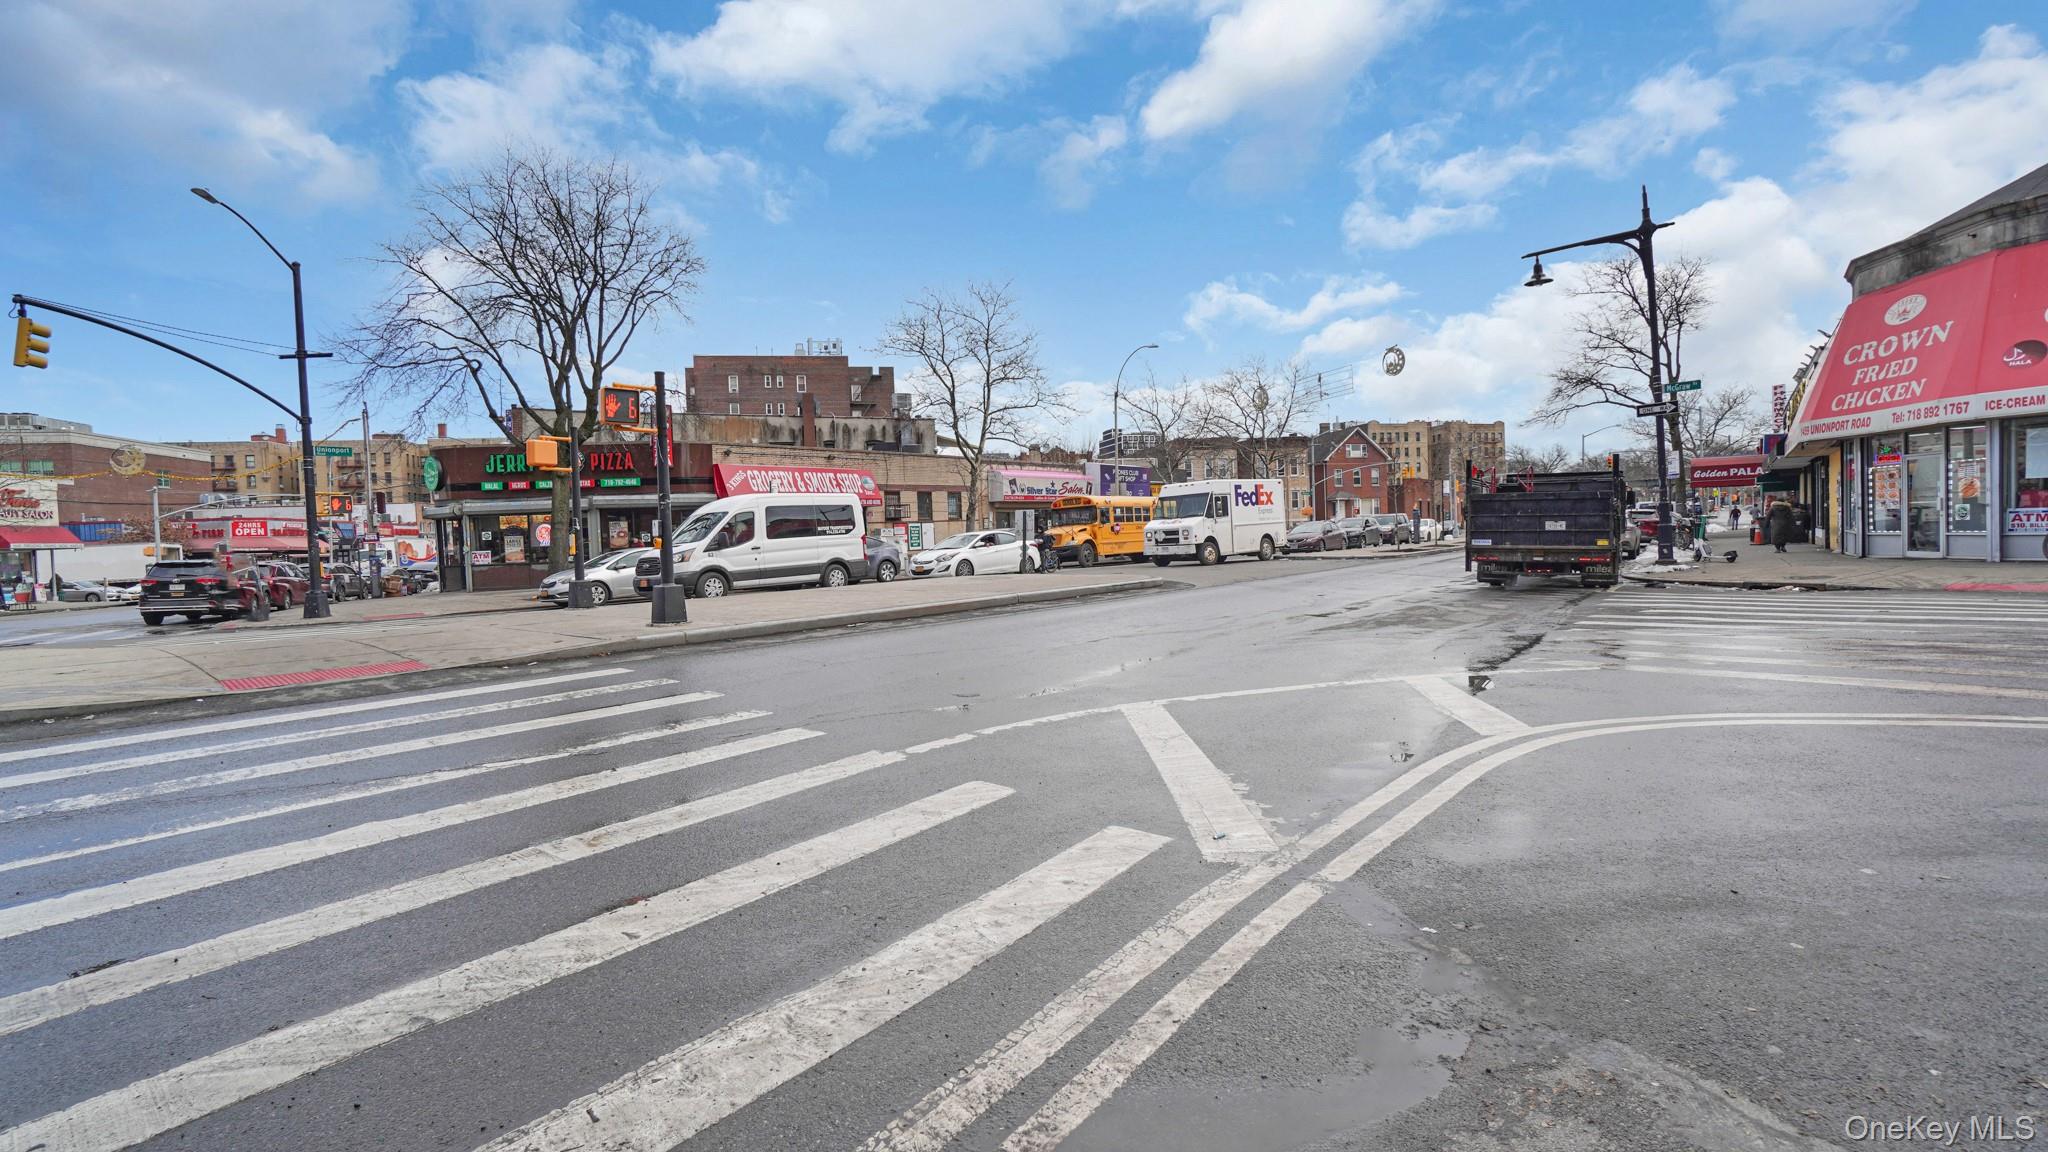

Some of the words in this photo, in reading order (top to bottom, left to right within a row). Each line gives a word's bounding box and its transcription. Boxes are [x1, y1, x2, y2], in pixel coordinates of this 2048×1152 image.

[1843, 320, 1954, 366] CROWN
[1851, 357, 1918, 386] FRIED
[1666, 383, 1691, 391] McGraw
[1831, 378, 1928, 412] CHICKEN
[628, 397, 637, 419] 6
[1984, 394, 2046, 411] ICE-CREAM
[1810, 419, 1850, 434] UNIONPORT
[1850, 416, 1872, 429] ROAD
[1891, 412, 1905, 424] Tel:
[1907, 408, 1921, 422] 718
[1923, 405, 1940, 418] 892
[1943, 401, 1970, 415] 1767
[316, 446, 350, 454] Unionport
[485, 454, 533, 473] JERR
[590, 451, 634, 471] PIZZA
[1693, 469, 1728, 478] Golden
[1730, 466, 1768, 477] PALA
[746, 470, 797, 493] GROCERY
[794, 471, 805, 493] &
[803, 471, 839, 494] SMOKE
[836, 473, 863, 493] SHOP
[1026, 486, 1043, 495] Silver
[1045, 486, 1057, 495] Star
[1058, 481, 1084, 495] Salon
[1234, 484, 1273, 507] FedEx
[2011, 513, 2048, 522] ATM
